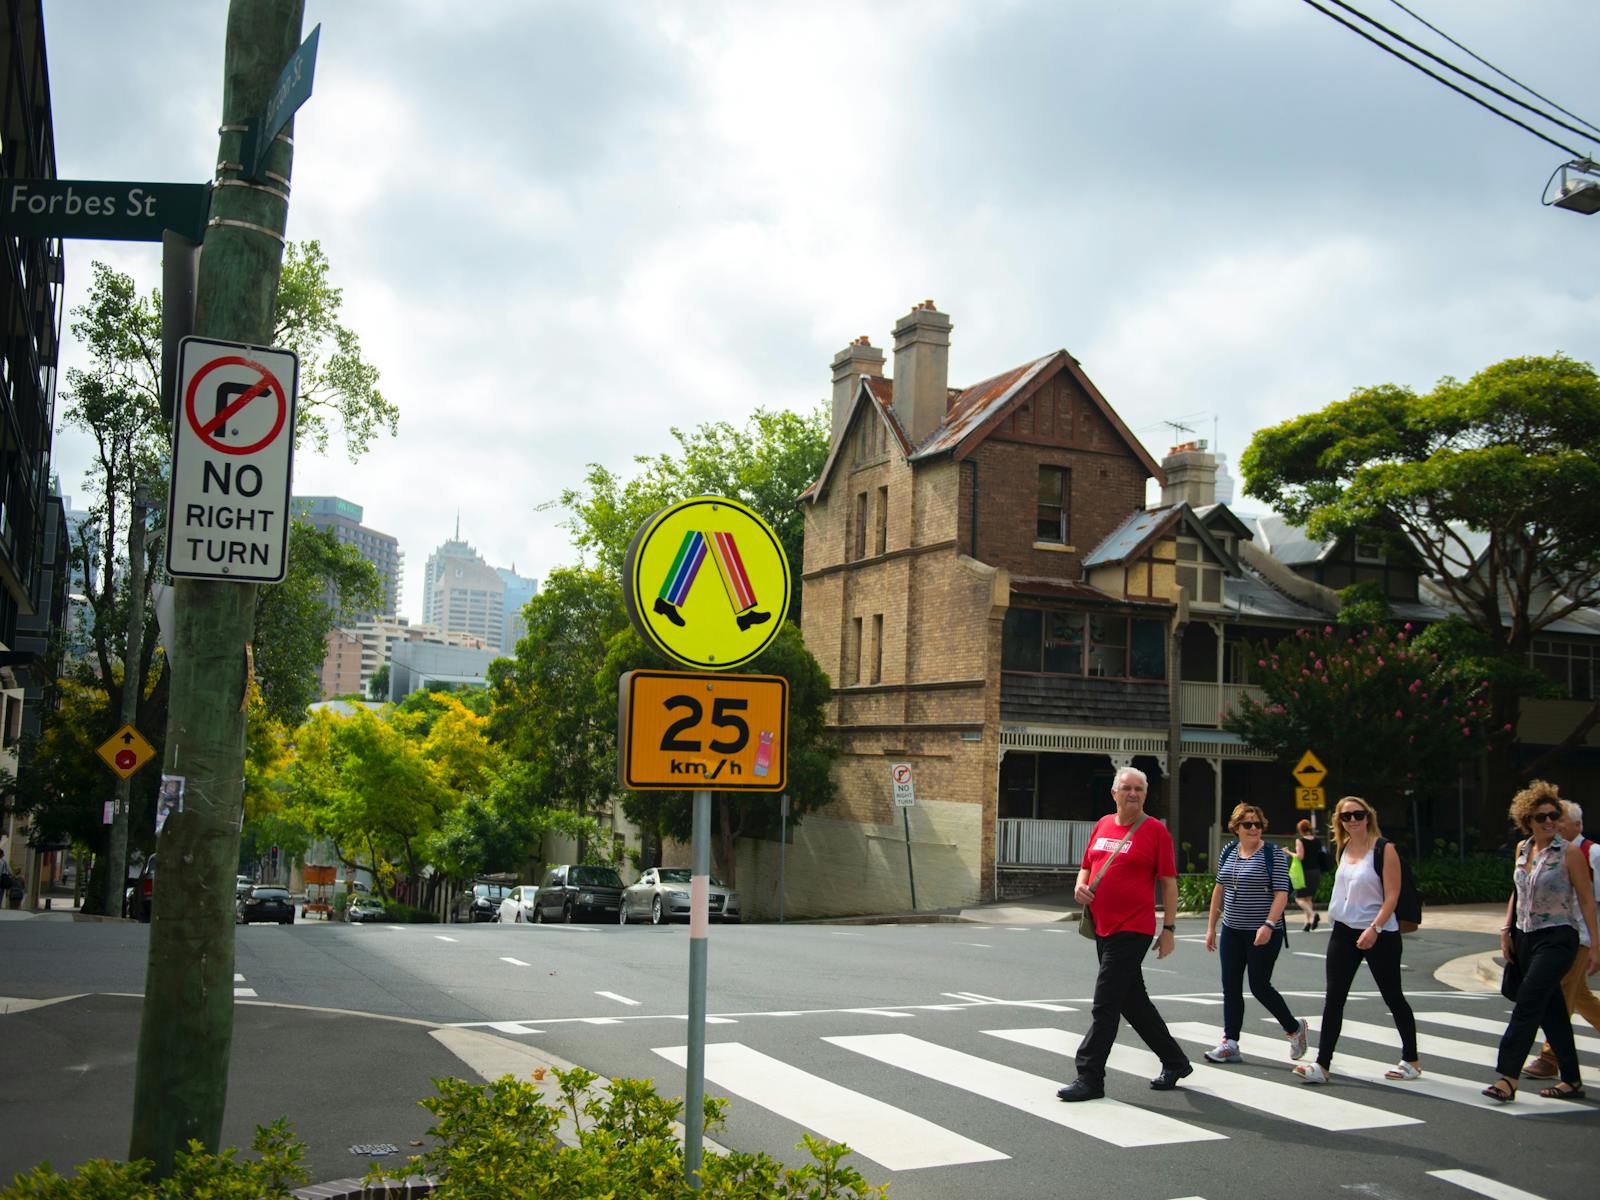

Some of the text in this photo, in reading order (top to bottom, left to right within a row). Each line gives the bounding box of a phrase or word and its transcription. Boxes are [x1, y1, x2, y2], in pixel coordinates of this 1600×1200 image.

[11, 185, 157, 217] Forbes St
[202, 460, 263, 498] NO
[186, 504, 274, 532] RIGHT
[187, 538, 269, 565] TURN
[659, 694, 750, 755] 25
[670, 759, 742, 780] km/h
[1302, 789, 1319, 801] 25
